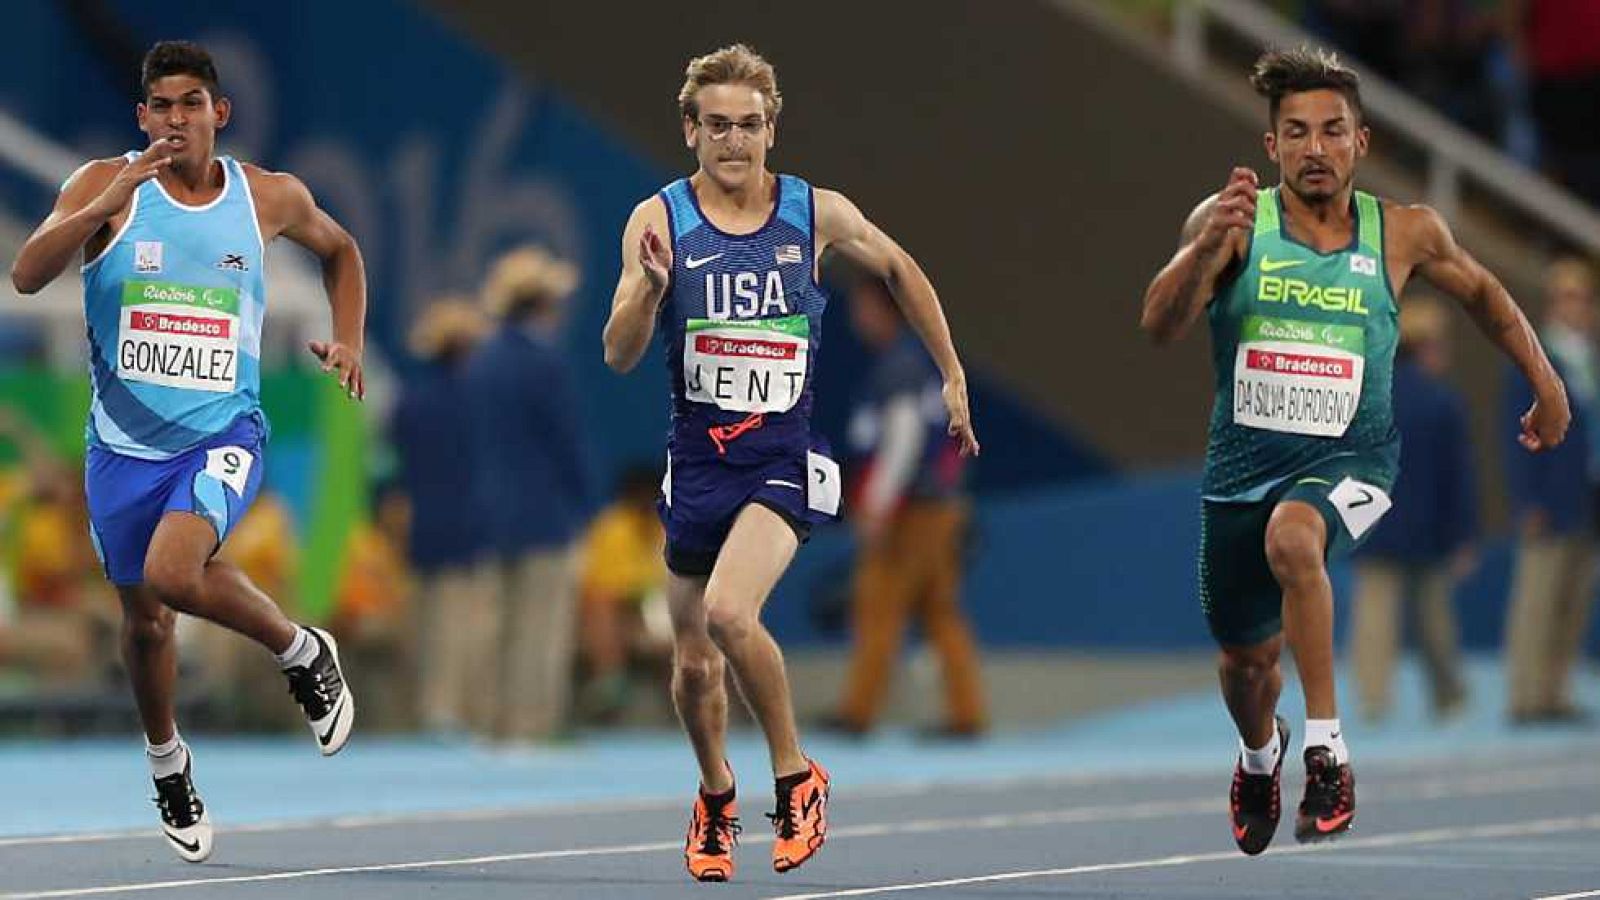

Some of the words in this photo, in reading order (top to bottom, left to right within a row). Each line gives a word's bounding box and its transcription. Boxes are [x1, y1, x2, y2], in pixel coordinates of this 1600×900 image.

[706, 270, 788, 319] USA
[1258, 275, 1369, 314] BRASIL
[158, 316, 221, 336] Bradesco
[120, 339, 235, 382] GONZALEZ
[724, 340, 786, 357] Bradesco
[1274, 355, 1343, 376] Bradesco
[1237, 380, 1252, 413] DA
[1254, 381, 1286, 420] SILVA
[224, 452, 241, 475] 9
